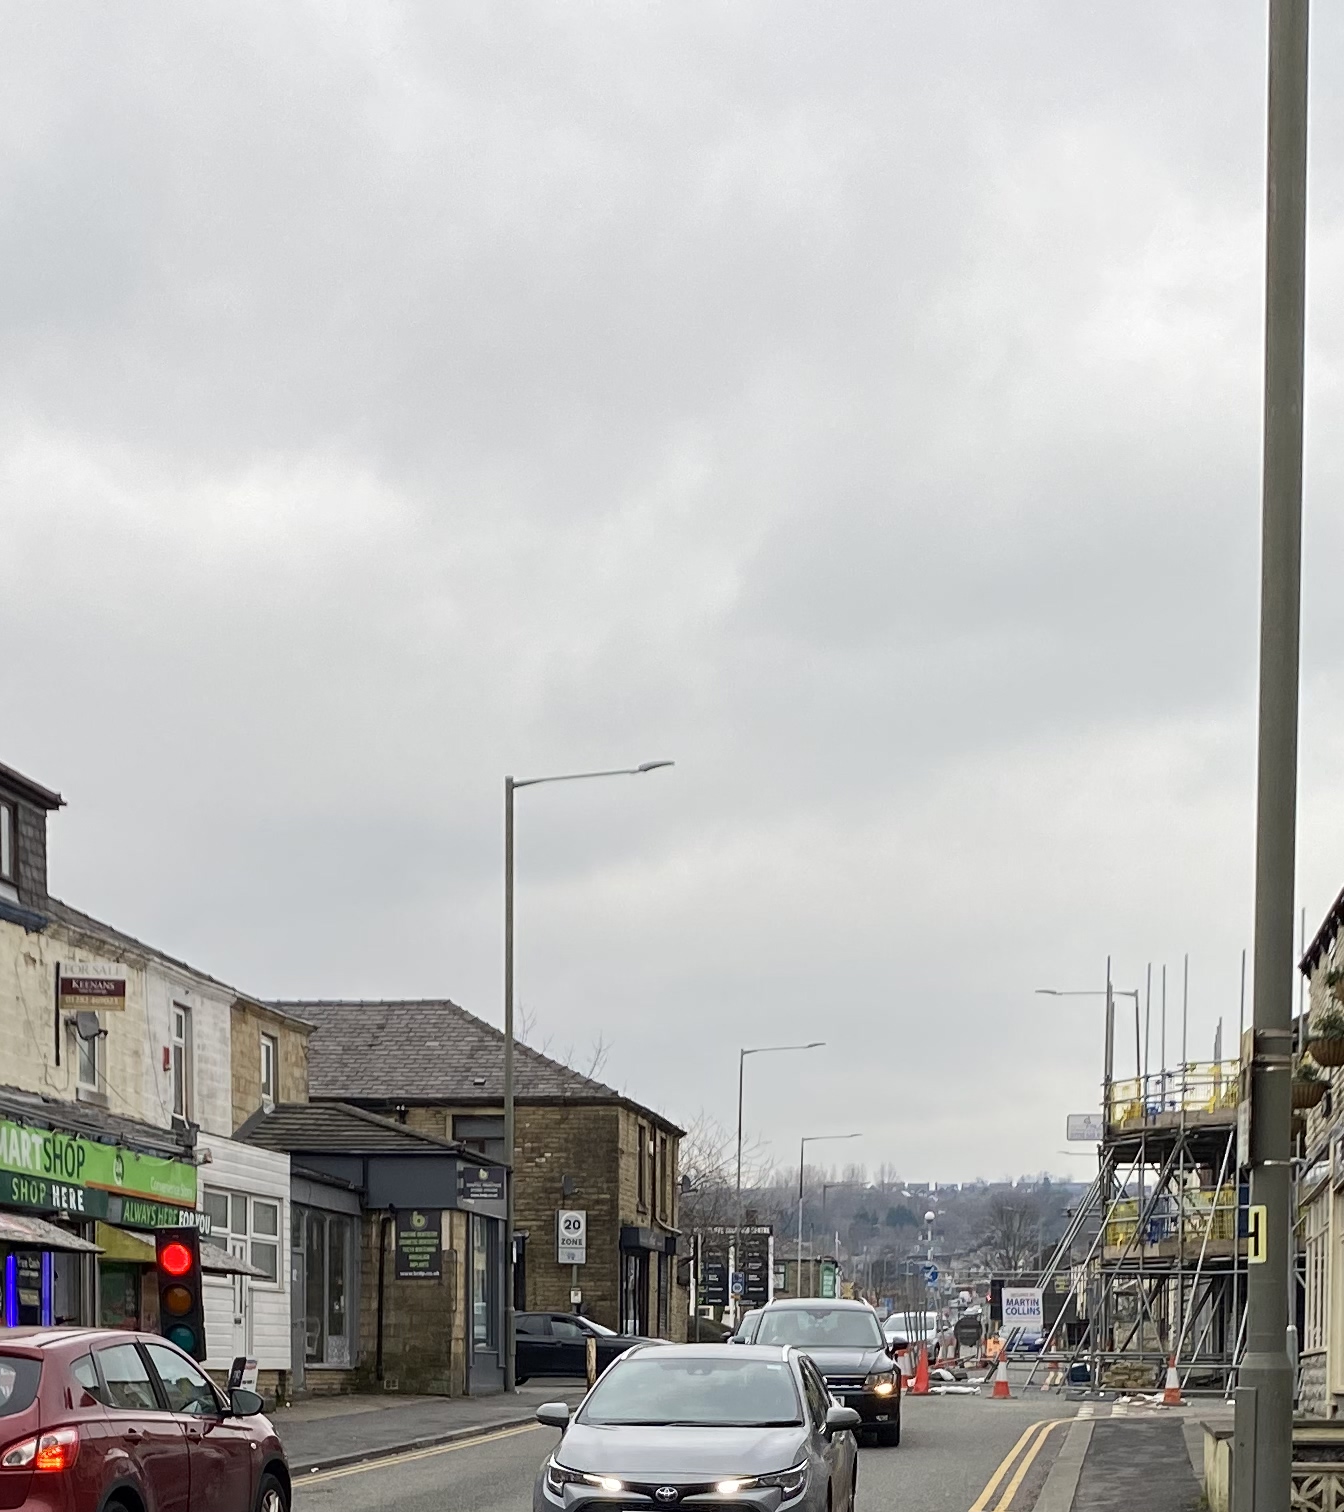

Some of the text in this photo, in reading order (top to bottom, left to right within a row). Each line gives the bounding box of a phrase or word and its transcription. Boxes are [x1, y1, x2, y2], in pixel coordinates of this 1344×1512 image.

[65, 965, 88, 975] FOR
[72, 980, 114, 990] KEENANS
[12, 1178, 85, 1212] SHOP HERE
[123, 1201, 211, 1235] ALWAYS HERE FOR YOU
[564, 1219, 580, 1230] 20
[1006, 1298, 1039, 1307] MARTIN
[1005, 1307, 1041, 1315] COLLINS
